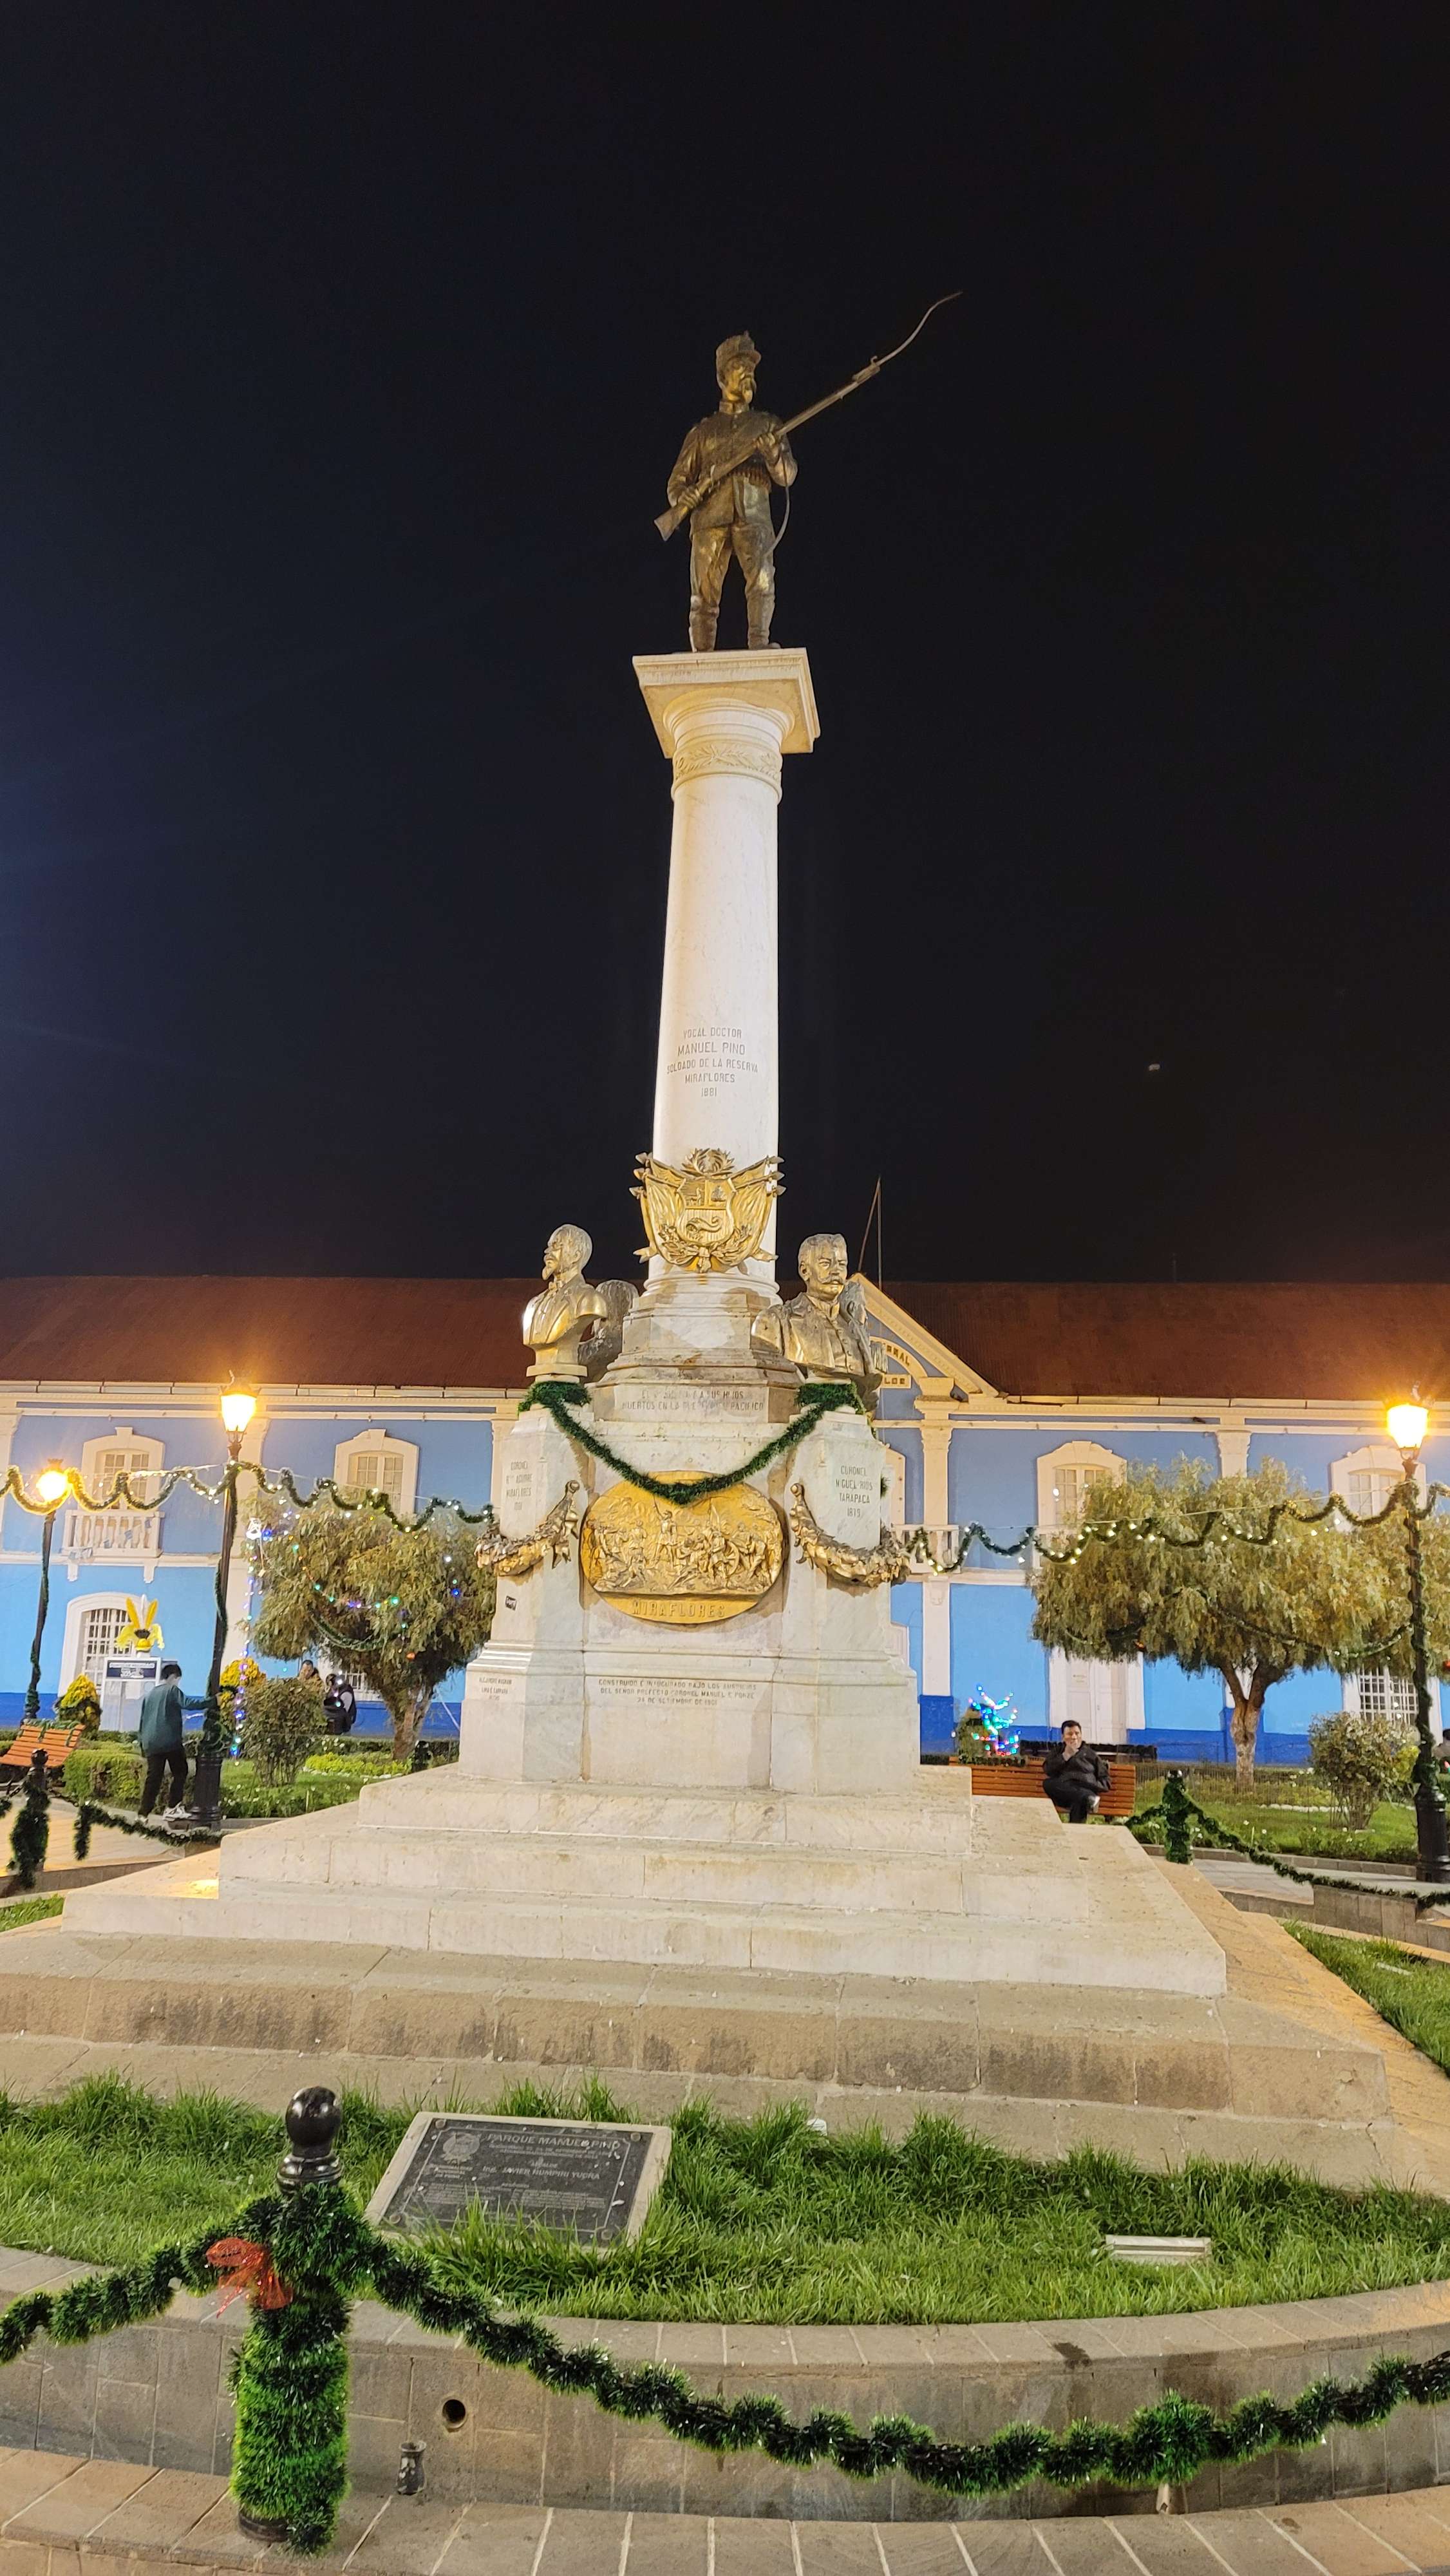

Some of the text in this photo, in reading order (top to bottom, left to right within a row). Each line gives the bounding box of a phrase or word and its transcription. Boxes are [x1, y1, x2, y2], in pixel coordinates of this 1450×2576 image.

[683, 1027, 742, 1039] VOCAL DOCTOR
[678, 1042, 746, 1056] MANUEL PINO
[667, 1058, 758, 1074] SOLDADO DE LA RESERVA
[685, 1073, 735, 1083] MIRAFLORES
[701, 1087, 717, 1097] 1881
[836, 1479, 857, 1489] MIGUEL
[840, 1493, 870, 1504] TARAPACA
[847, 1507, 861, 1517] 1879
[632, 1600, 725, 1618] MIRAFLORES
[487, 2134, 536, 2144] PARQUE
[538, 2137, 588, 2146] MANUE
[591, 2140, 621, 2150] PINO
[572, 2172, 600, 2180] YUCRA
